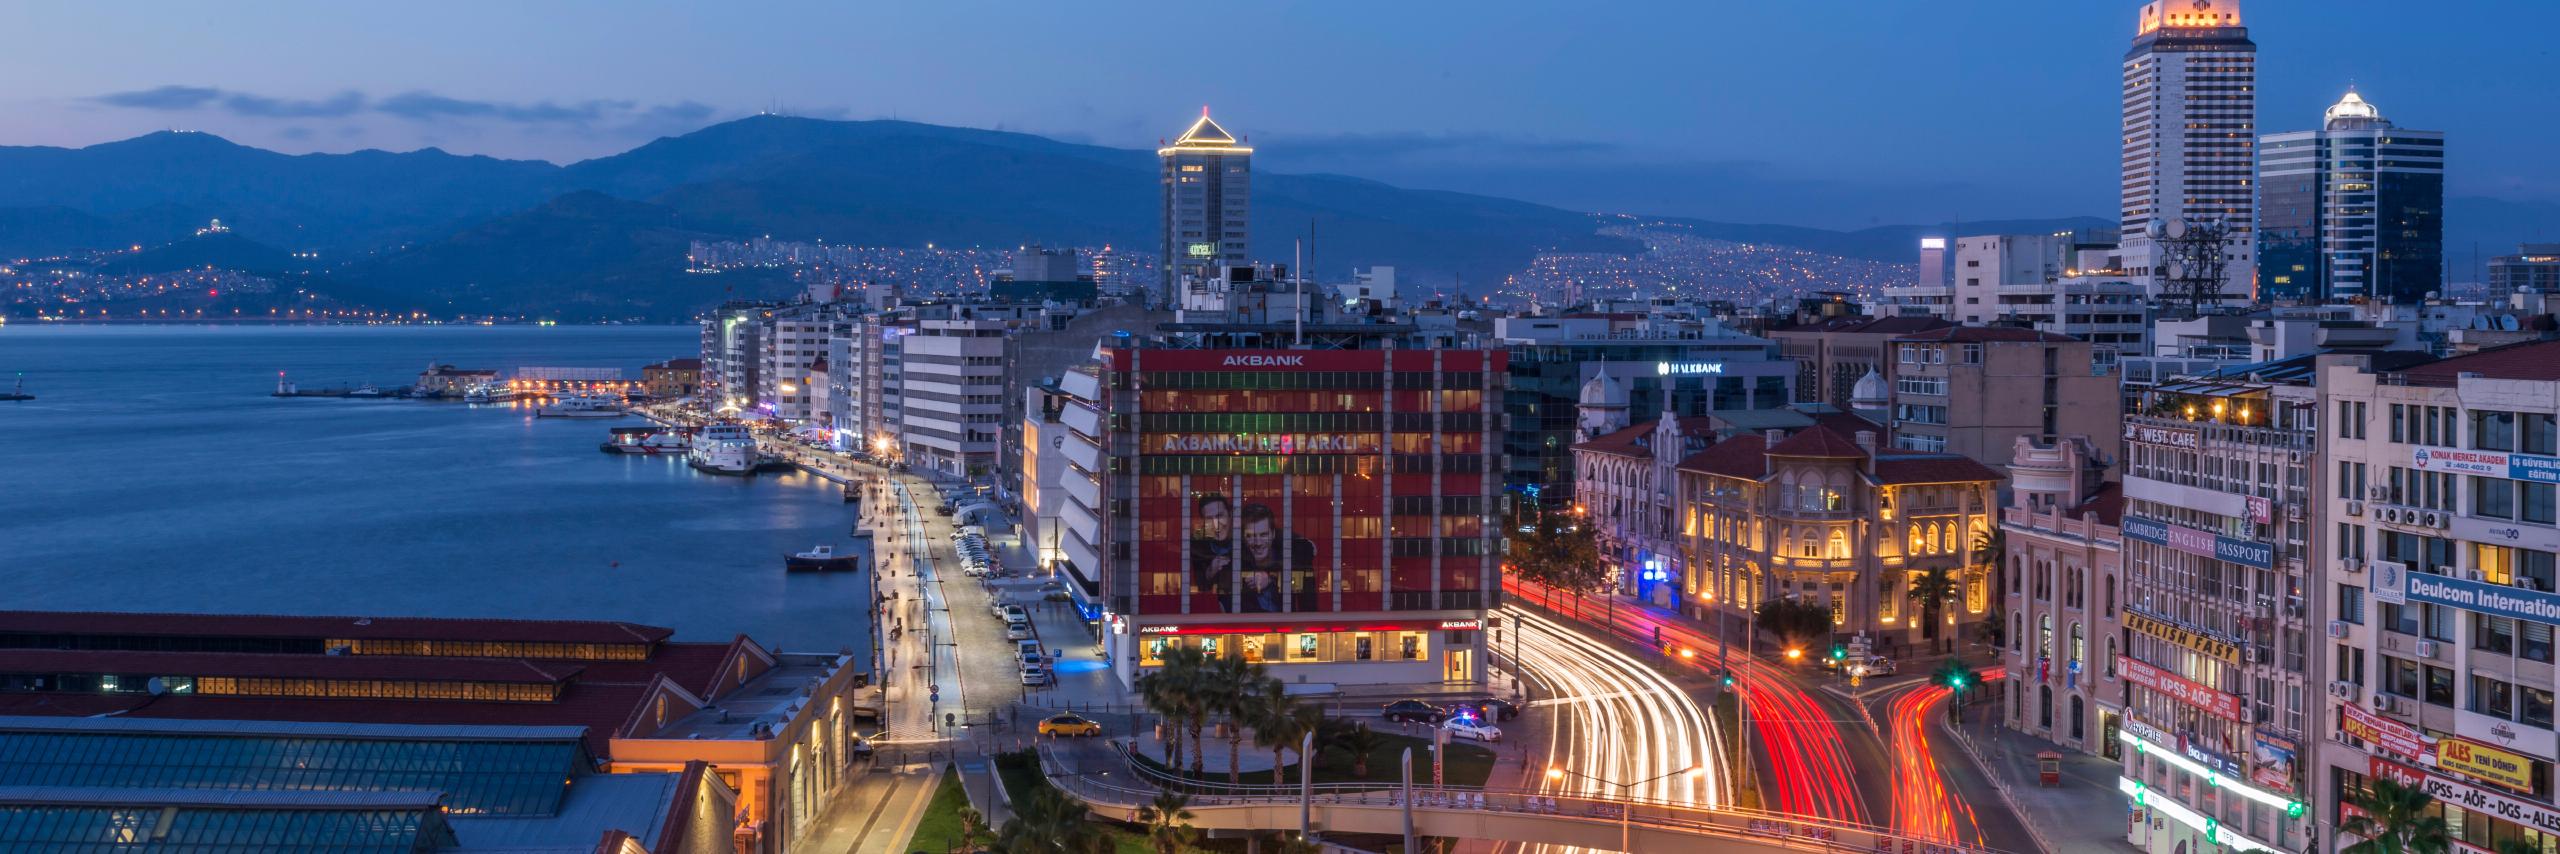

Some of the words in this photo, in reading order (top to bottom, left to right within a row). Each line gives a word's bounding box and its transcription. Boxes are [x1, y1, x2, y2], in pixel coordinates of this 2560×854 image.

[1223, 355, 1304, 366] AKBANK
[1671, 363, 1722, 374] HALKBANK
[2143, 428, 2167, 444] WEST
[2170, 431, 2196, 448] CAFE
[2430, 450, 2452, 460] KONAK
[2452, 452, 2477, 463] MERKEZ
[2123, 520, 2167, 542] CAMBRIDGE
[2169, 532, 2215, 551] ENGLISH
[2217, 541, 2270, 563] PASSPORT
[2411, 578, 2474, 606] Deulcom
[2127, 614, 2188, 646] ENGLISH
[2194, 636, 2234, 660] FAST
[2130, 661, 2156, 677] TEOREM
[2160, 676, 2187, 698] KPSS
[2191, 687, 2213, 707] AÖF
[2345, 717, 2367, 739] KPSS
[2446, 741, 2471, 763] ALES
[2474, 753, 2491, 768] YENİ
[2492, 758, 2518, 774] DÖNEM
[2427, 779, 2453, 799] KPSS
[2463, 789, 2487, 809] AÖF
[2498, 800, 2521, 820] DGS
[2532, 810, 2560, 832] ALES
